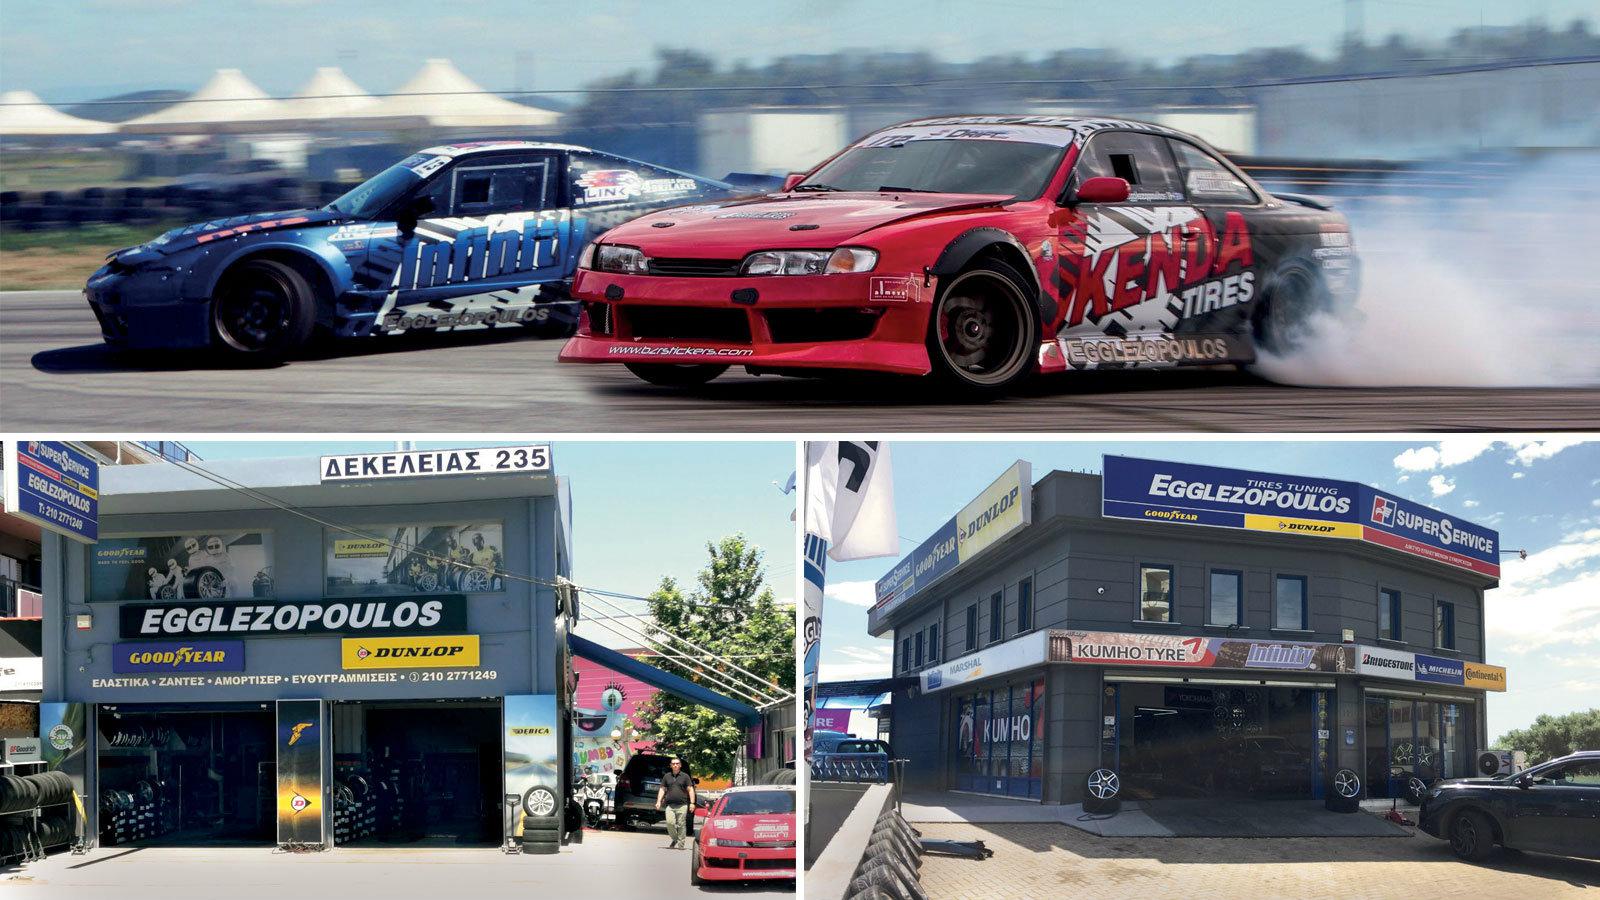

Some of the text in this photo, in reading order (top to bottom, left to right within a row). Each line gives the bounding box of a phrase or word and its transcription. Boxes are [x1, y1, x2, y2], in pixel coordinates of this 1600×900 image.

[586, 186, 626, 199] LINK
[1067, 211, 1254, 328] KENDA
[1182, 271, 1255, 319] TIRES
[1067, 338, 1229, 363] EGGLEZOPOULOS
[325, 447, 546, 478] ΔΕΚΕΛΕΙΑΣ 235
[28, 472, 91, 514] EGGLEZOPOULOS
[1247, 478, 1338, 496] TIRES TUNING
[45, 505, 58, 520] 210
[58, 511, 83, 530] 2771249
[967, 485, 1019, 539] DUNLOP
[1145, 509, 1198, 522] GOODYEAR
[1288, 522, 1336, 533] DUNLOP
[97, 547, 145, 557] GOODYEAR
[915, 536, 956, 577] GOODYEAR
[140, 600, 443, 634] EGGLEZOPOULOS
[129, 647, 225, 667] GOODYEAR
[374, 646, 464, 658] DUNLOP
[1078, 644, 1186, 662] KUMHO TYRE
[949, 657, 982, 674] MARSHAL
[1362, 653, 1414, 671] BRIDGESTONE
[1428, 665, 1463, 677] MICHELIN
[92, 671, 497, 688] ΕΛΑΣΤΙΚΑ ΖΑΝΤΕΣ ΑΜΟΡΤΙΣΕΡ ΕΥΘΥΓΡΑΜΜΙΣΕΙΣ 210 2771249
[1465, 668, 1499, 682] Continental
